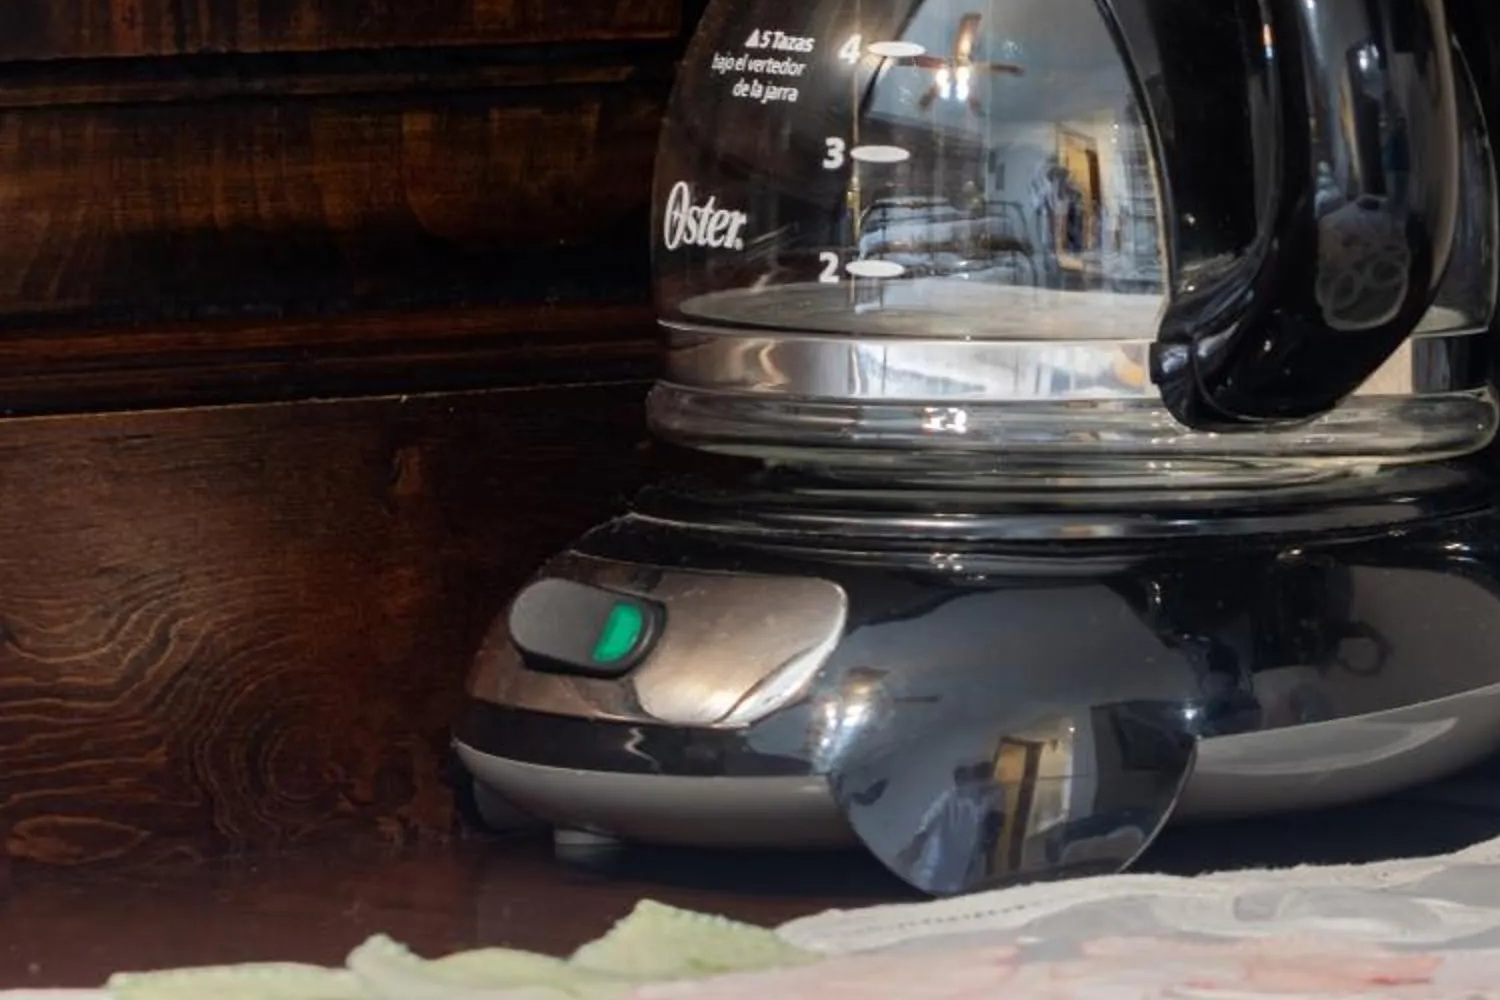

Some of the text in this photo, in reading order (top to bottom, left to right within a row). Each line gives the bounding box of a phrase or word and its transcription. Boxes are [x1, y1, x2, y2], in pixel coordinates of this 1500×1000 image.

[772, 30, 816, 53] Tazas
[838, 33, 862, 65] 4
[735, 53, 749, 72] el
[748, 56, 807, 77] vertedor
[732, 77, 800, 105] de la jarra
[821, 137, 846, 170] 3
[818, 251, 841, 284] 2
